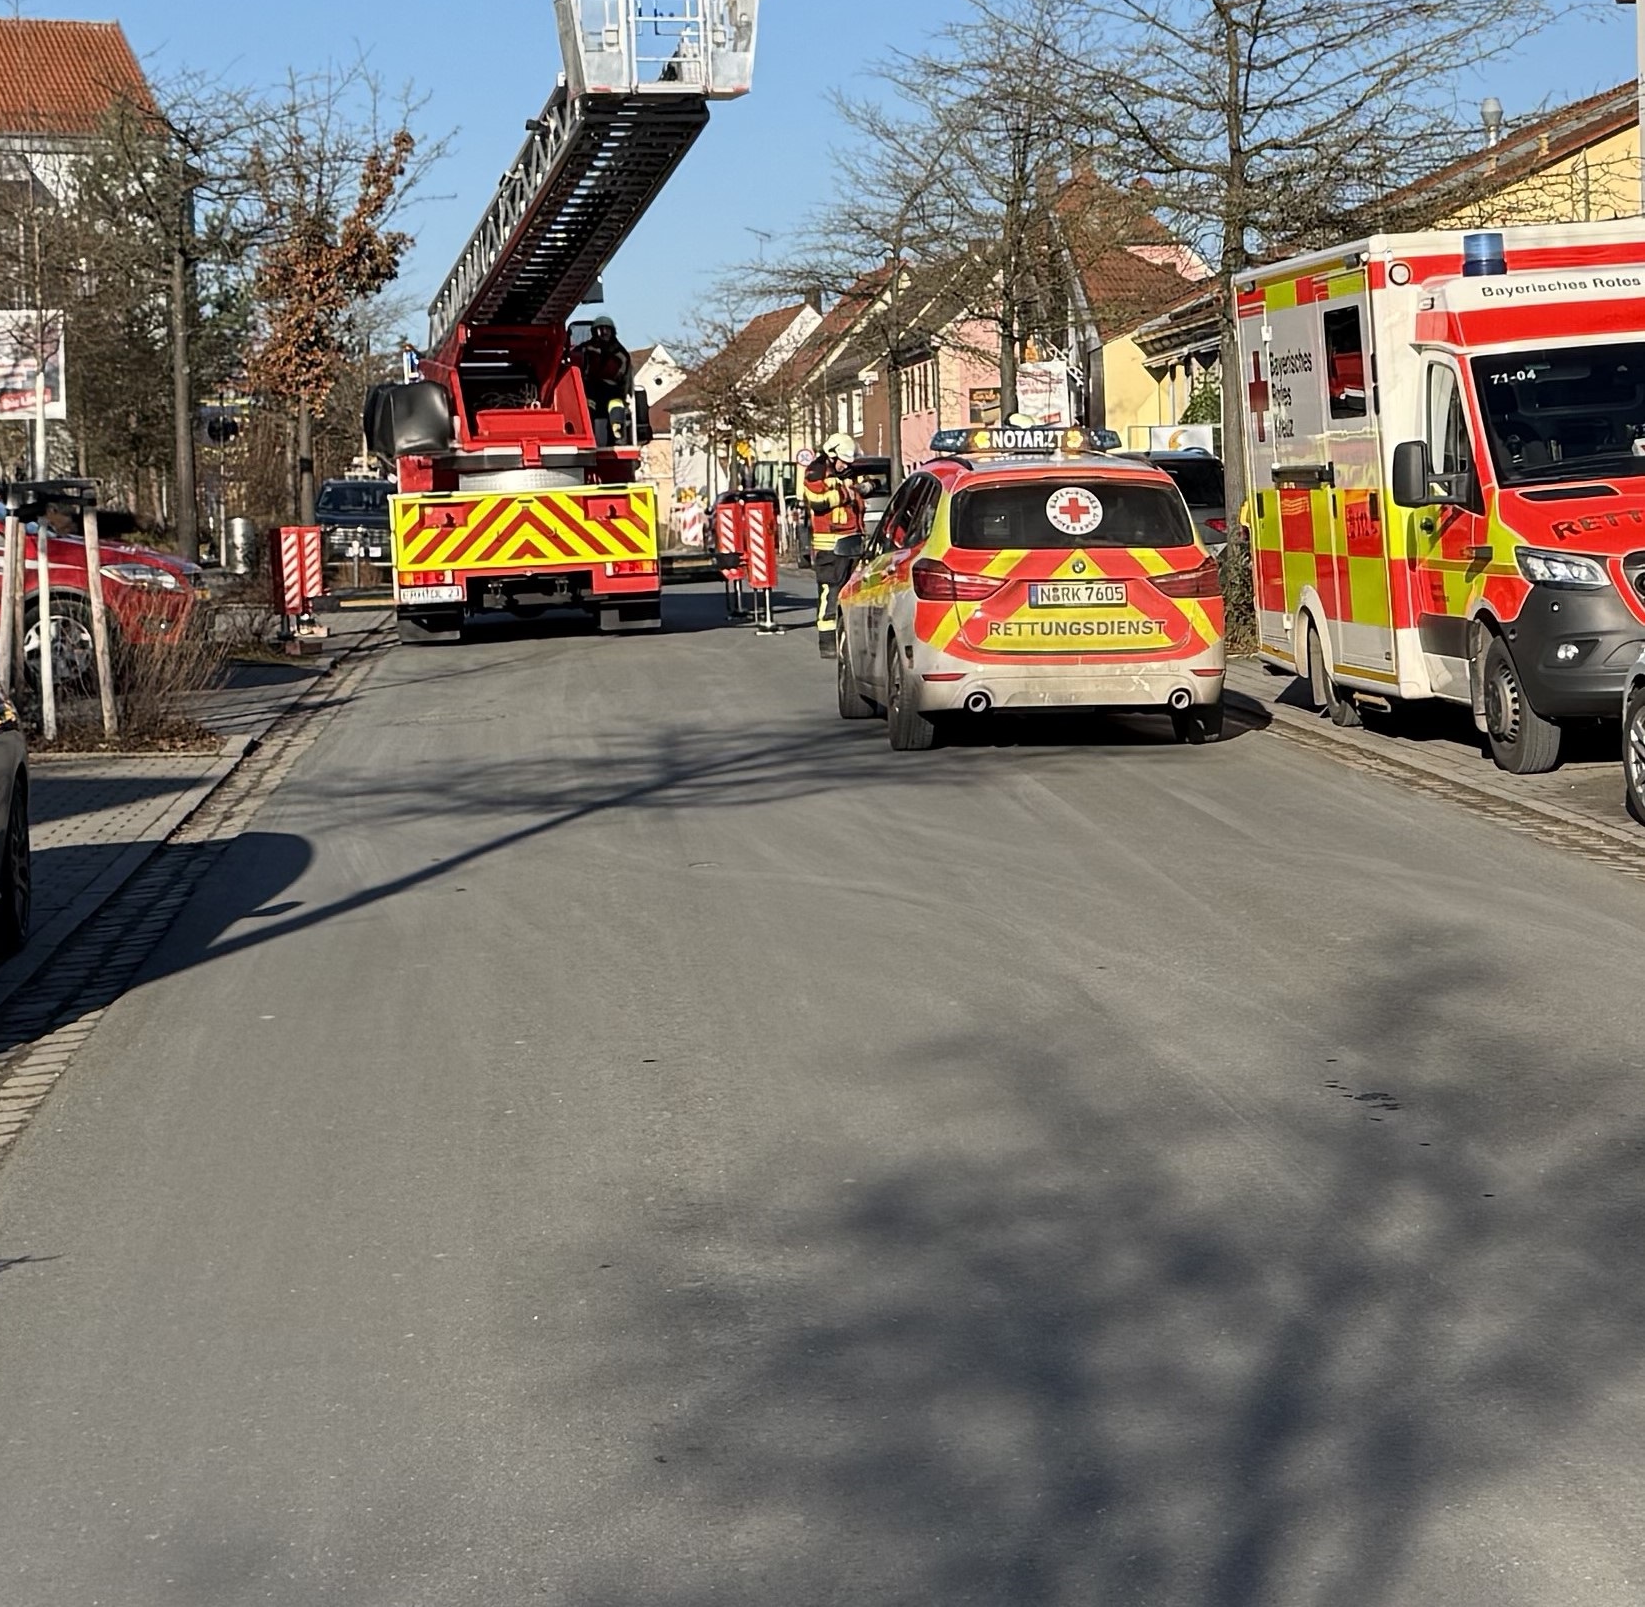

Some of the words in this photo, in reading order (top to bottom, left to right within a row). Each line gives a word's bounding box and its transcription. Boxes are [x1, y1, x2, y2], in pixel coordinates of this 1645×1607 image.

[1481, 279, 1588, 298] Bayerisches
[1591, 277, 1642, 289] Rotes
[992, 430, 1065, 448] NOTARZT
[1084, 585, 1125, 602] 7605
[989, 620, 1165, 637] RETTUNGSDIENST
